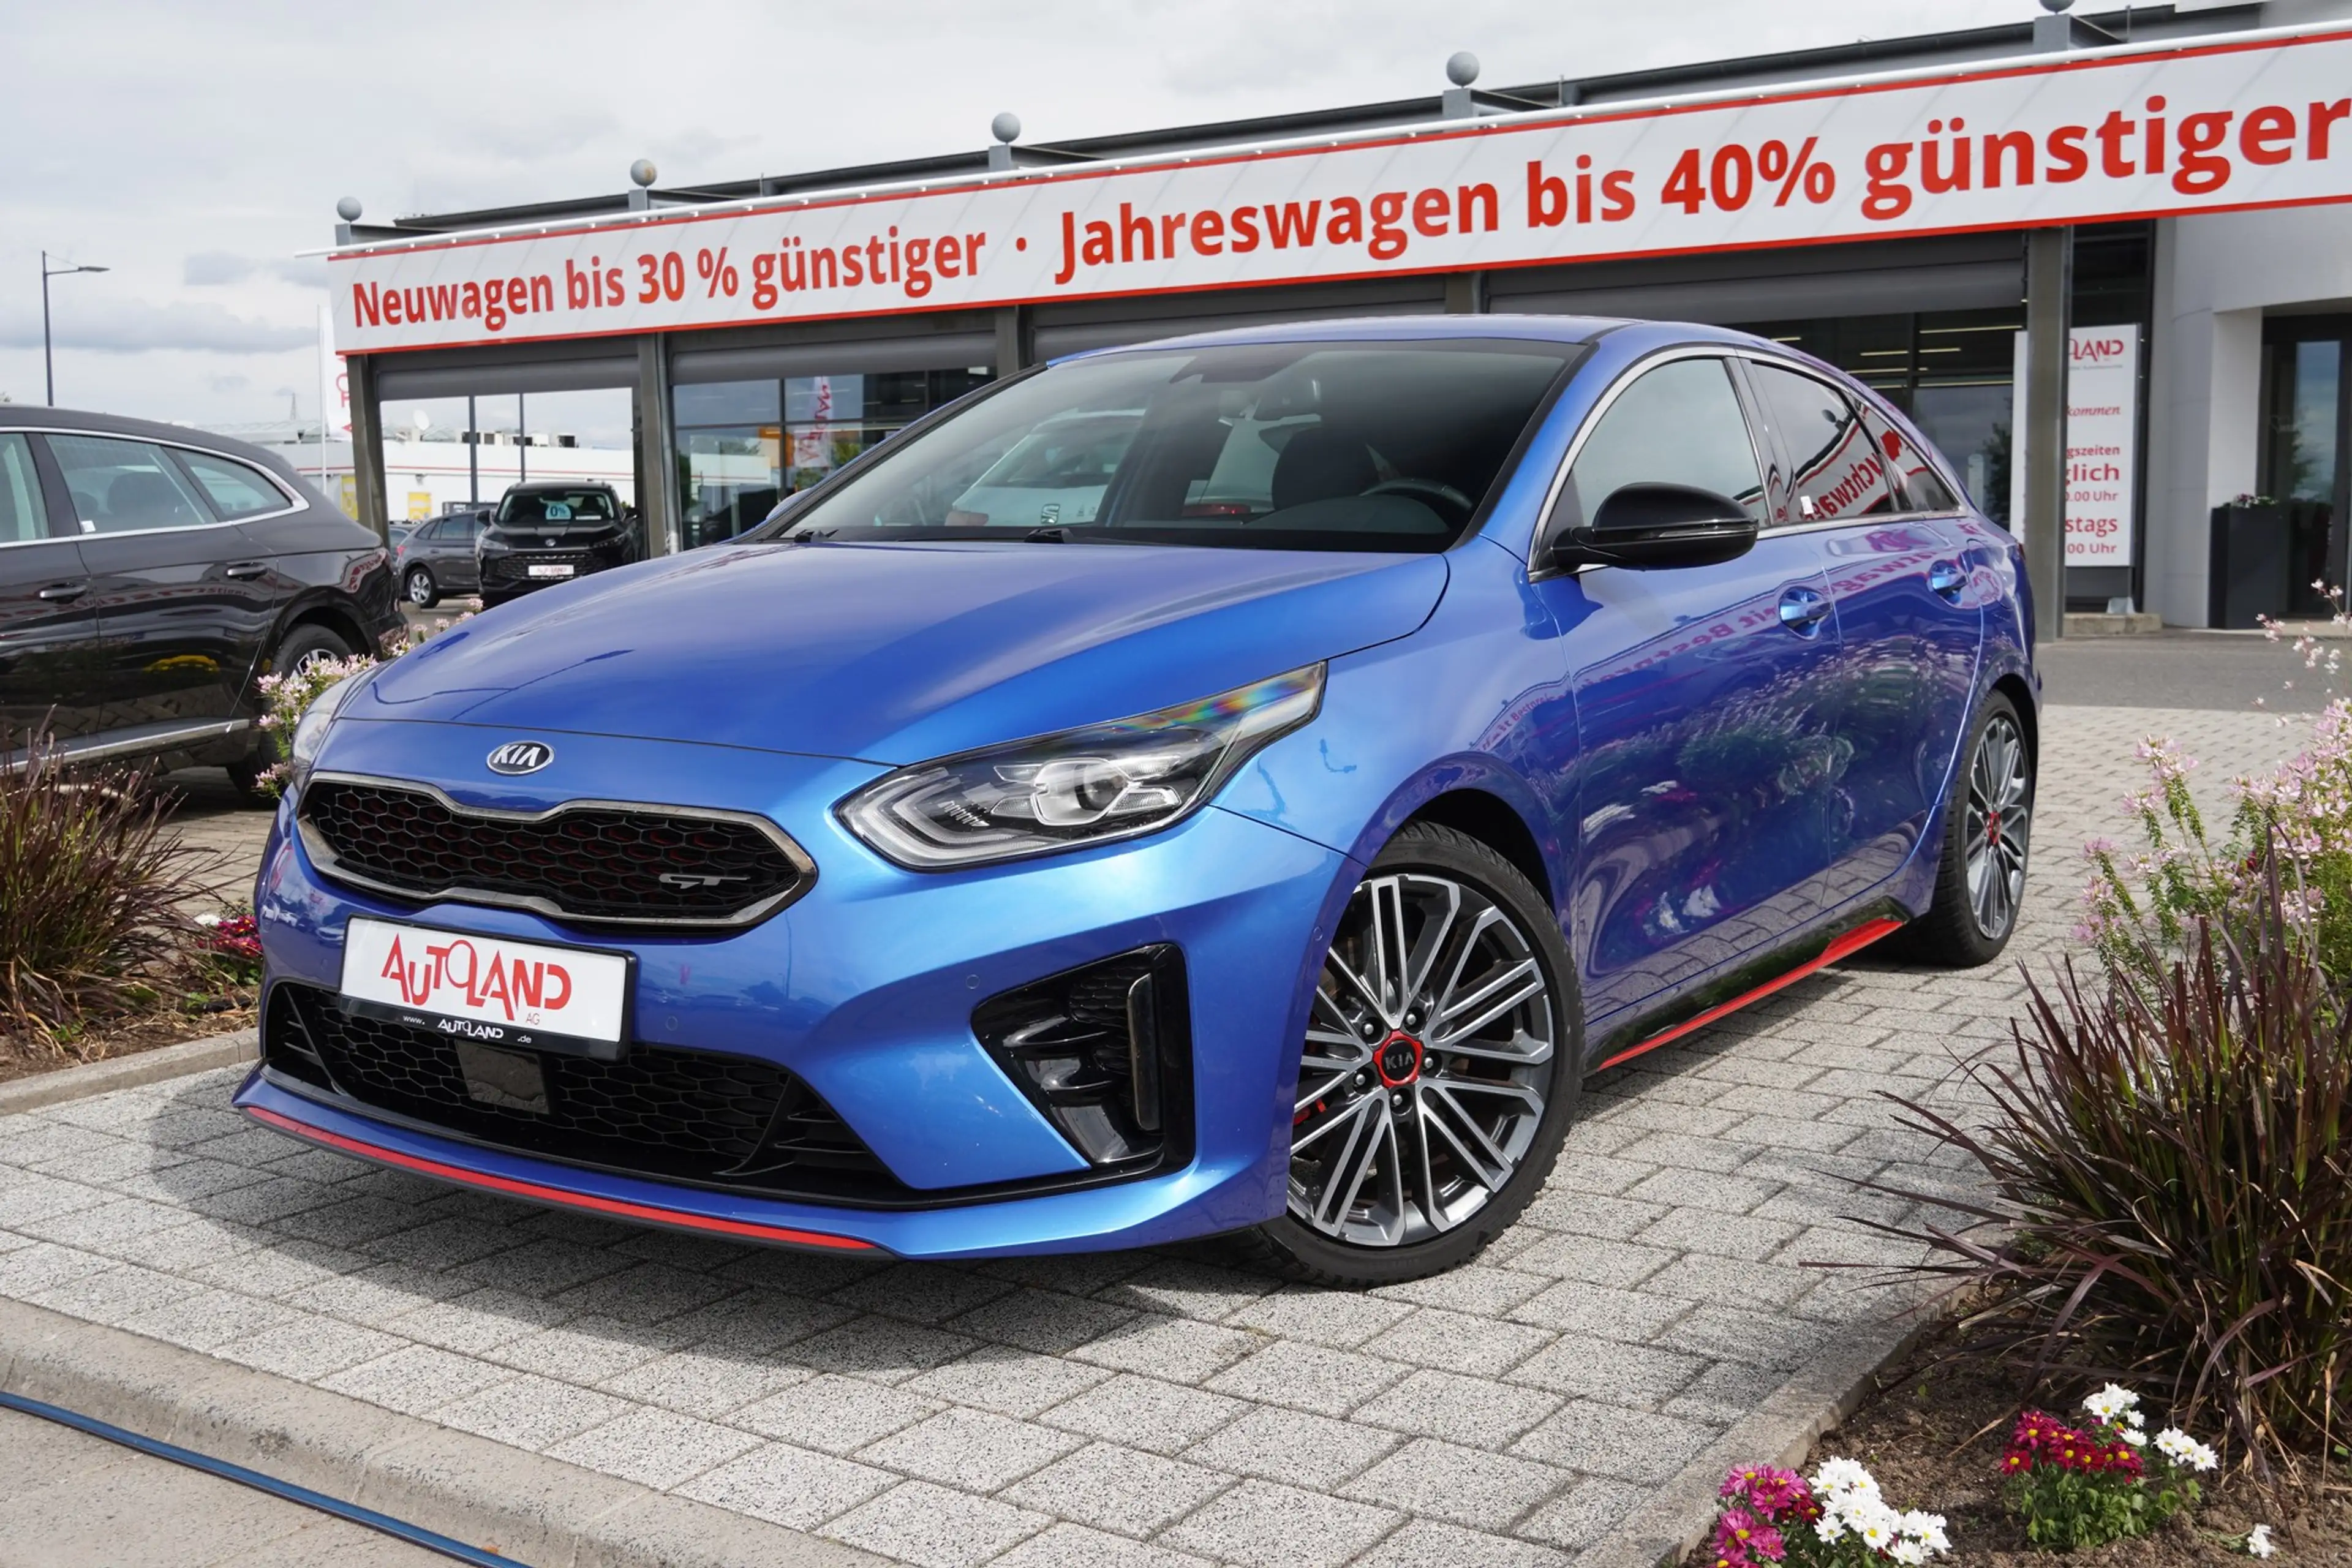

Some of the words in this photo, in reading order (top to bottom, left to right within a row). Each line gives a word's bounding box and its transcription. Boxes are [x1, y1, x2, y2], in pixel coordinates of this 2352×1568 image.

[352, 274, 554, 331] Neuwagen
[565, 256, 625, 309] bis
[637, 251, 685, 304] 30
[696, 247, 739, 298] %
[752, 225, 987, 311] günstiger
[1054, 182, 1499, 286] Jahreswagen
[1526, 154, 1636, 228] bis
[1660, 136, 1836, 215] 40%
[1861, 94, 2352, 221] günstiger
[2067, 405, 2121, 417] kommen
[2066, 445, 2120, 459] gszeiten
[2092, 491, 2118, 502] Uhr
[2065, 517, 2118, 538] stags
[2089, 543, 2117, 554] Uhr
[493, 744, 541, 767] KIA
[658, 873, 751, 889] GT
[381, 933, 572, 1020] AUTOLAND
[526, 1012, 540, 1026] AG
[437, 1017, 504, 1039] AUTOLAND
[1385, 1052, 1414, 1070] KIA
